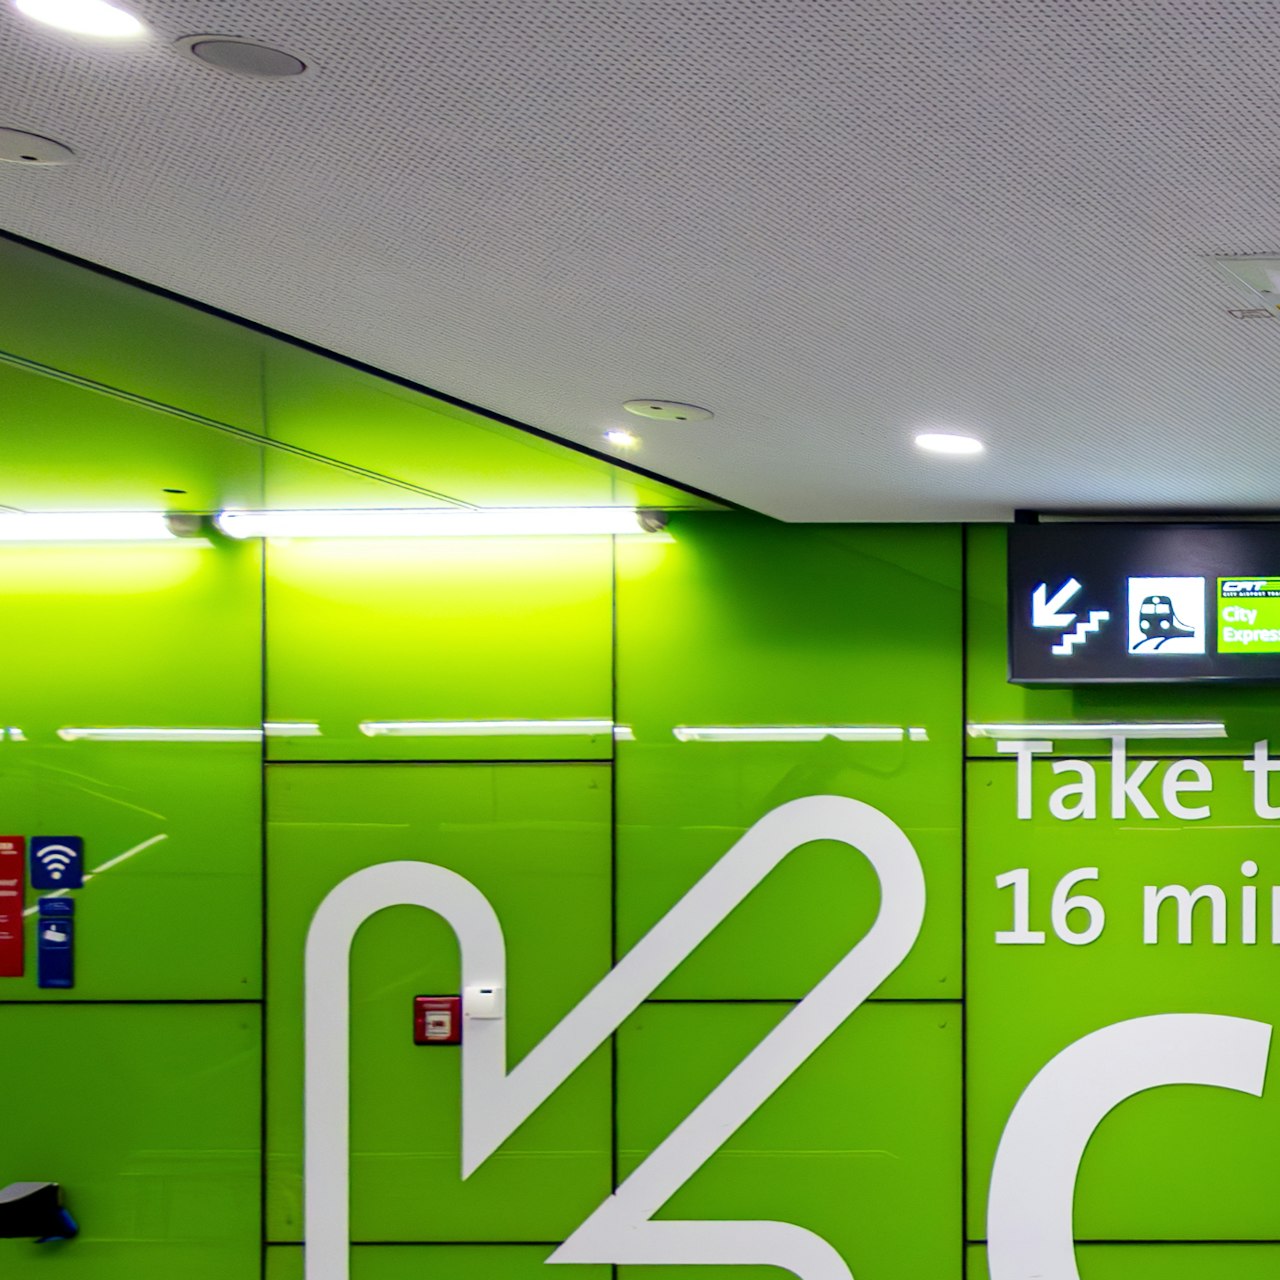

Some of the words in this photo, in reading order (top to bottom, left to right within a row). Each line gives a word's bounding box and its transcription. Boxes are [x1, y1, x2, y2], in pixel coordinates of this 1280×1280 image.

[1222, 605, 1258, 625] City
[996, 734, 1213, 820] Take
[994, 867, 1105, 945] 16
